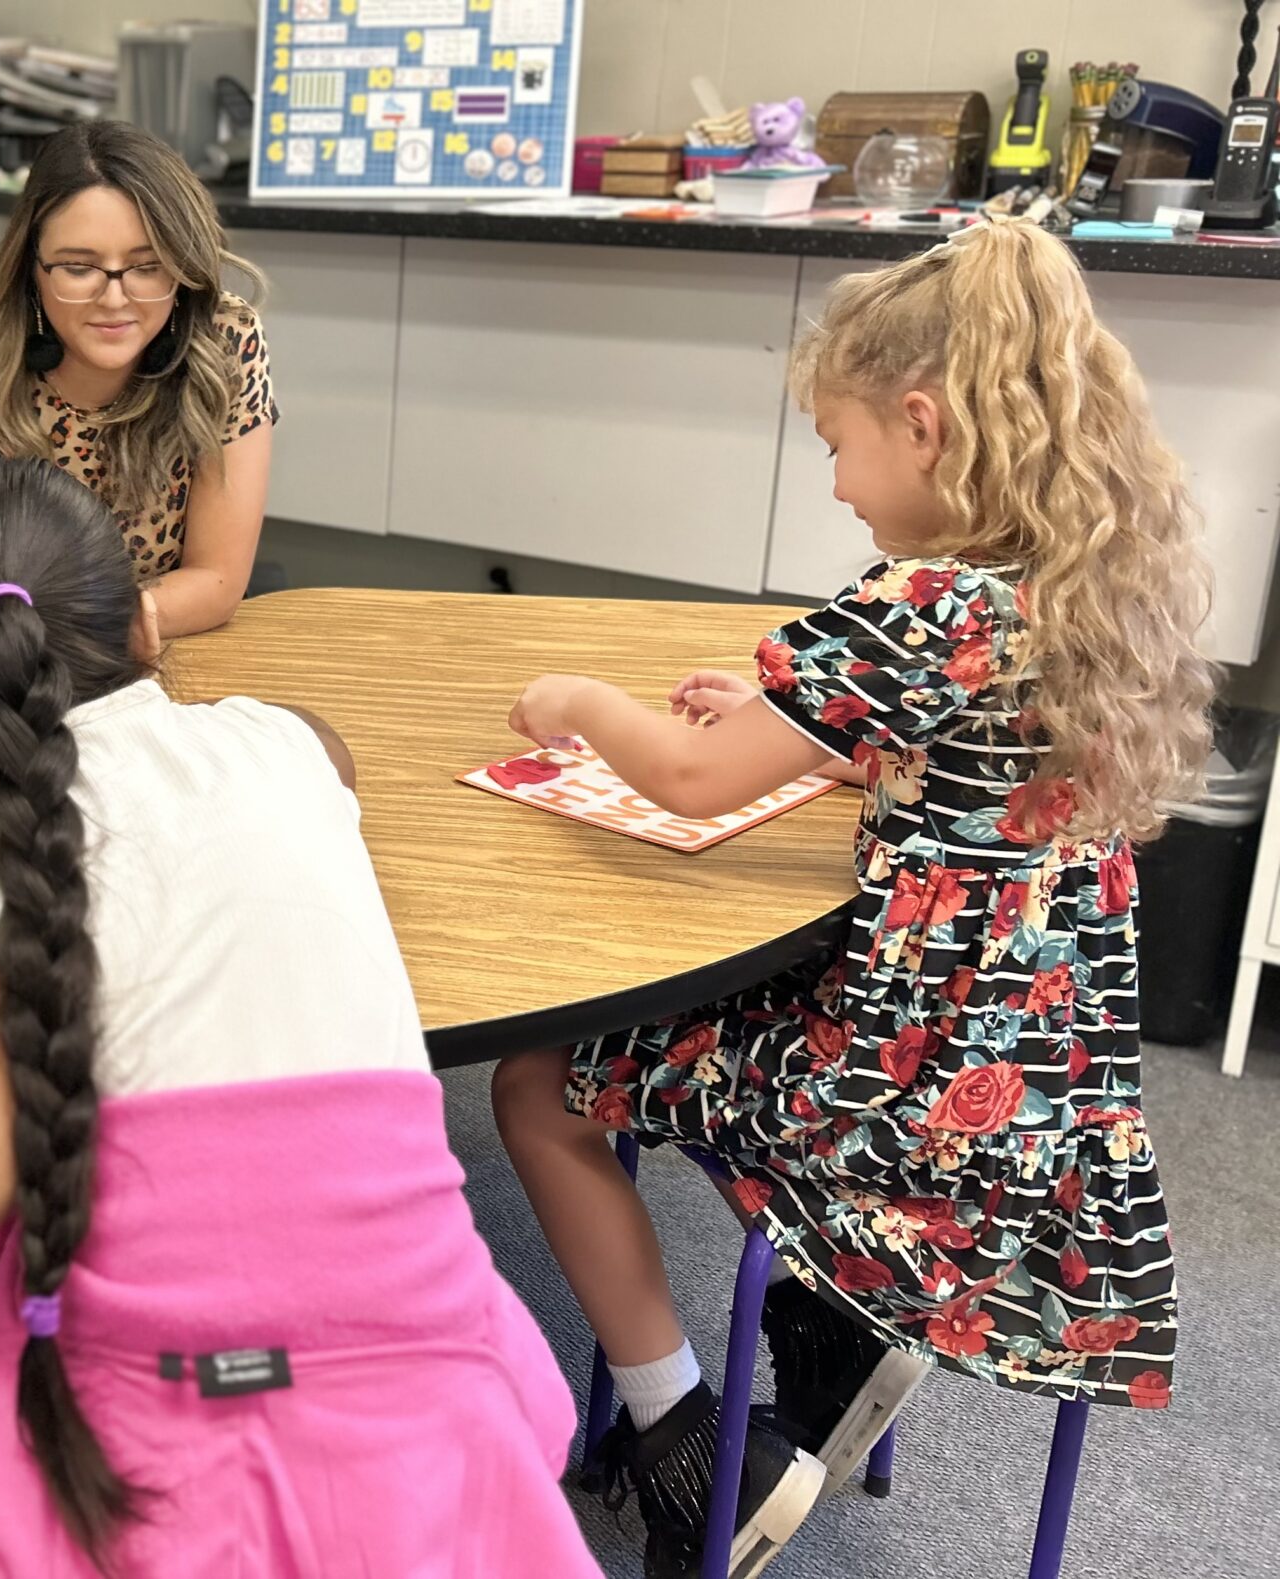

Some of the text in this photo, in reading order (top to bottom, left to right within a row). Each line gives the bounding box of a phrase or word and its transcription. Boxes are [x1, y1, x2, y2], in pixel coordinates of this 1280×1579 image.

[275, 22, 293, 45] 2
[405, 31, 424, 52] 9
[274, 47, 290, 70] 3
[272, 74, 288, 95] 4
[368, 66, 394, 89] 10
[270, 112, 286, 135] 5
[267, 140, 285, 163] 6
[322, 140, 336, 160] 7
